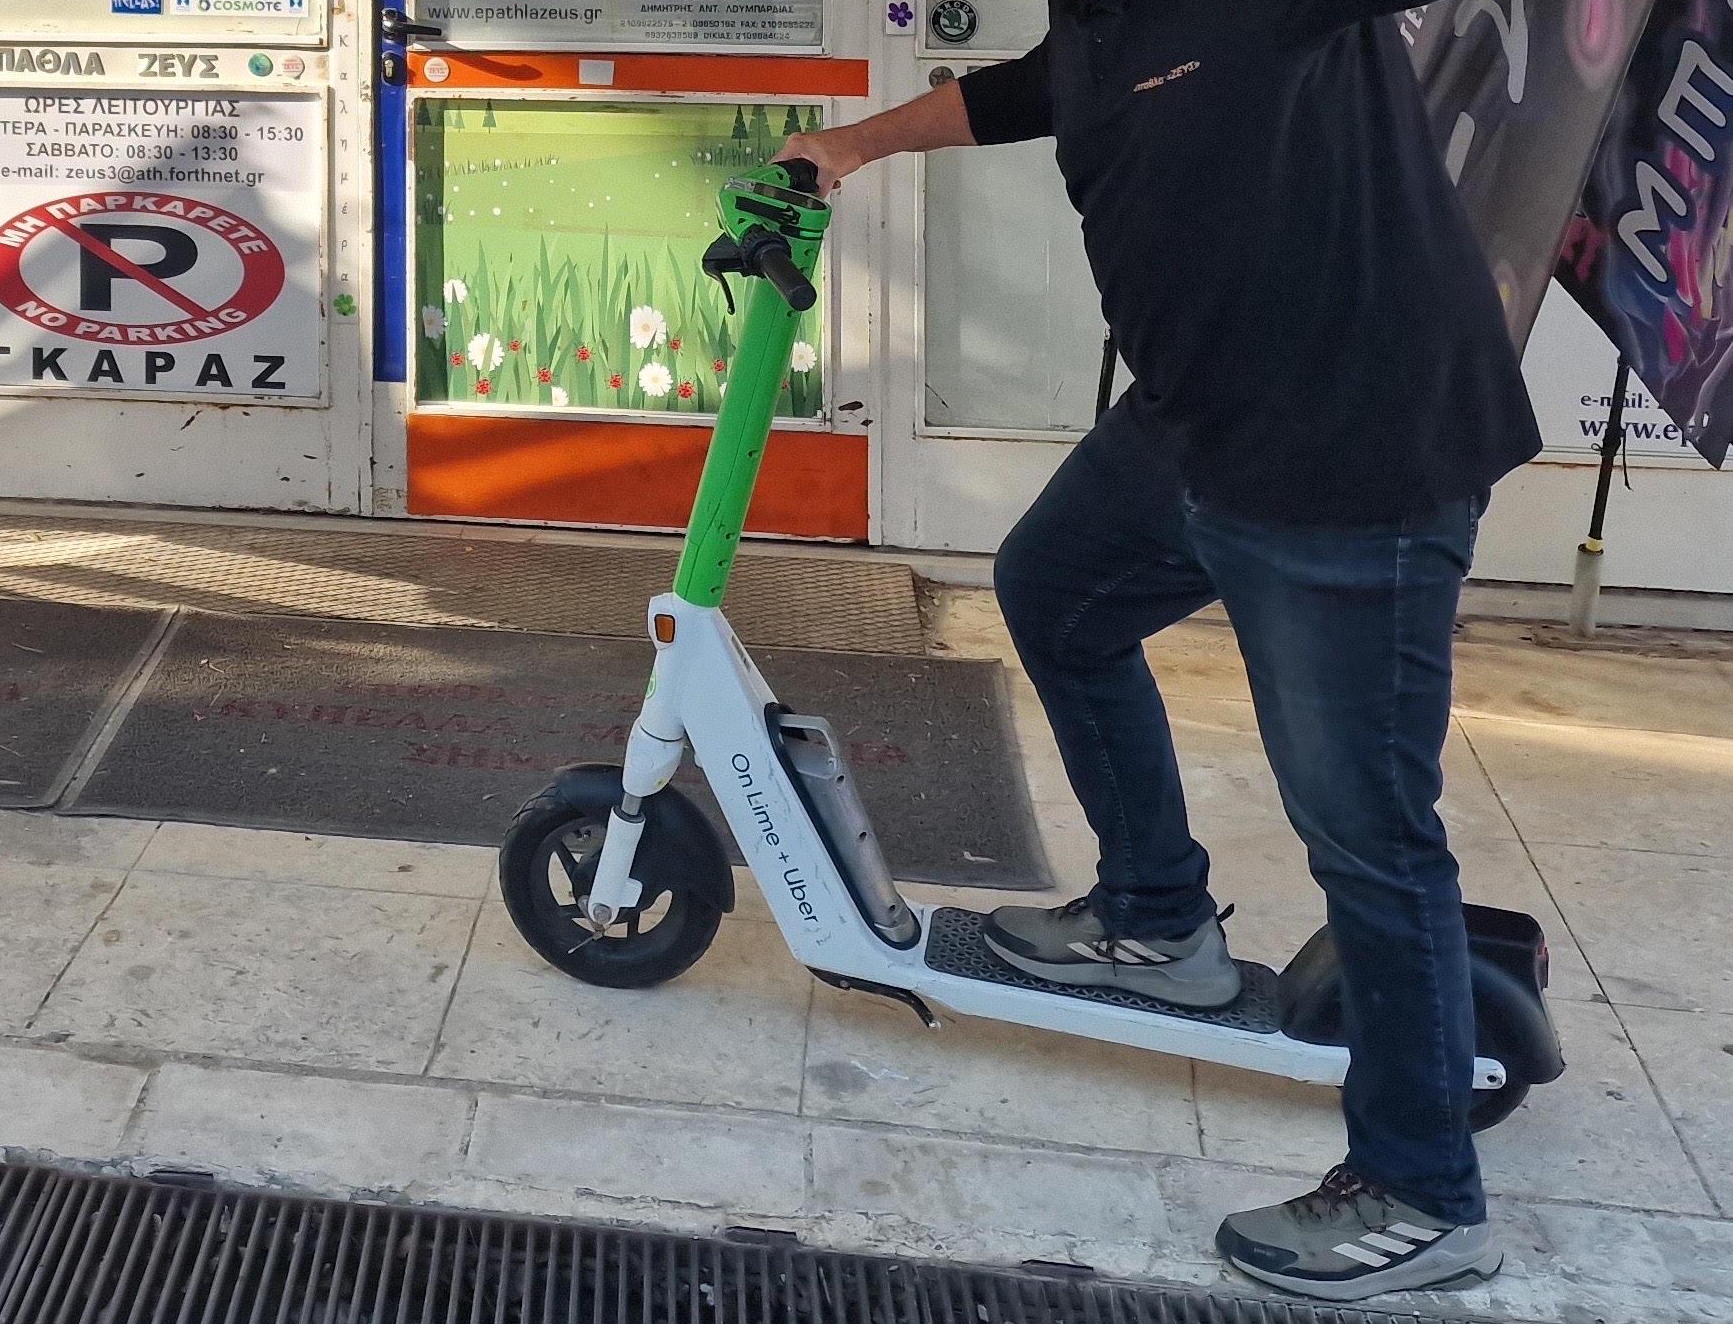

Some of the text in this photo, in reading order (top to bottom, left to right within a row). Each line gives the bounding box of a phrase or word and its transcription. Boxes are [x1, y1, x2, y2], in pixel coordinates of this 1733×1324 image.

[213, 0, 283, 12] COSMOTE
[427, 3, 603, 24] www.epathlazeus.gr
[640, 4, 693, 14] ΔΗΜΗΤΡΗΣ
[137, 52, 221, 79] ΖΕΥΣ
[23, 96, 241, 117] ΩΡΕΣ ΛΕΙΤΟΥΡΓΙΑΣ
[64, 122, 185, 139] ΠΑΡΑΣΚΕΥΗ:
[190, 125, 239, 142] 08:30
[256, 126, 305, 143] 15:30
[25, 143, 239, 162] ΣΑΒΒΑΤΟ: 08:30 13:30
[0, 164, 266, 185] e-mail: zeus3@ath.forthnet.gr
[45, 195, 270, 256] ΠΑΡΚΑΡΕΤΕ
[14, 299, 248, 343] NO PARKING
[731, 752, 753, 788] On
[746, 787, 781, 848] Lime
[782, 867, 821, 924] Uber
